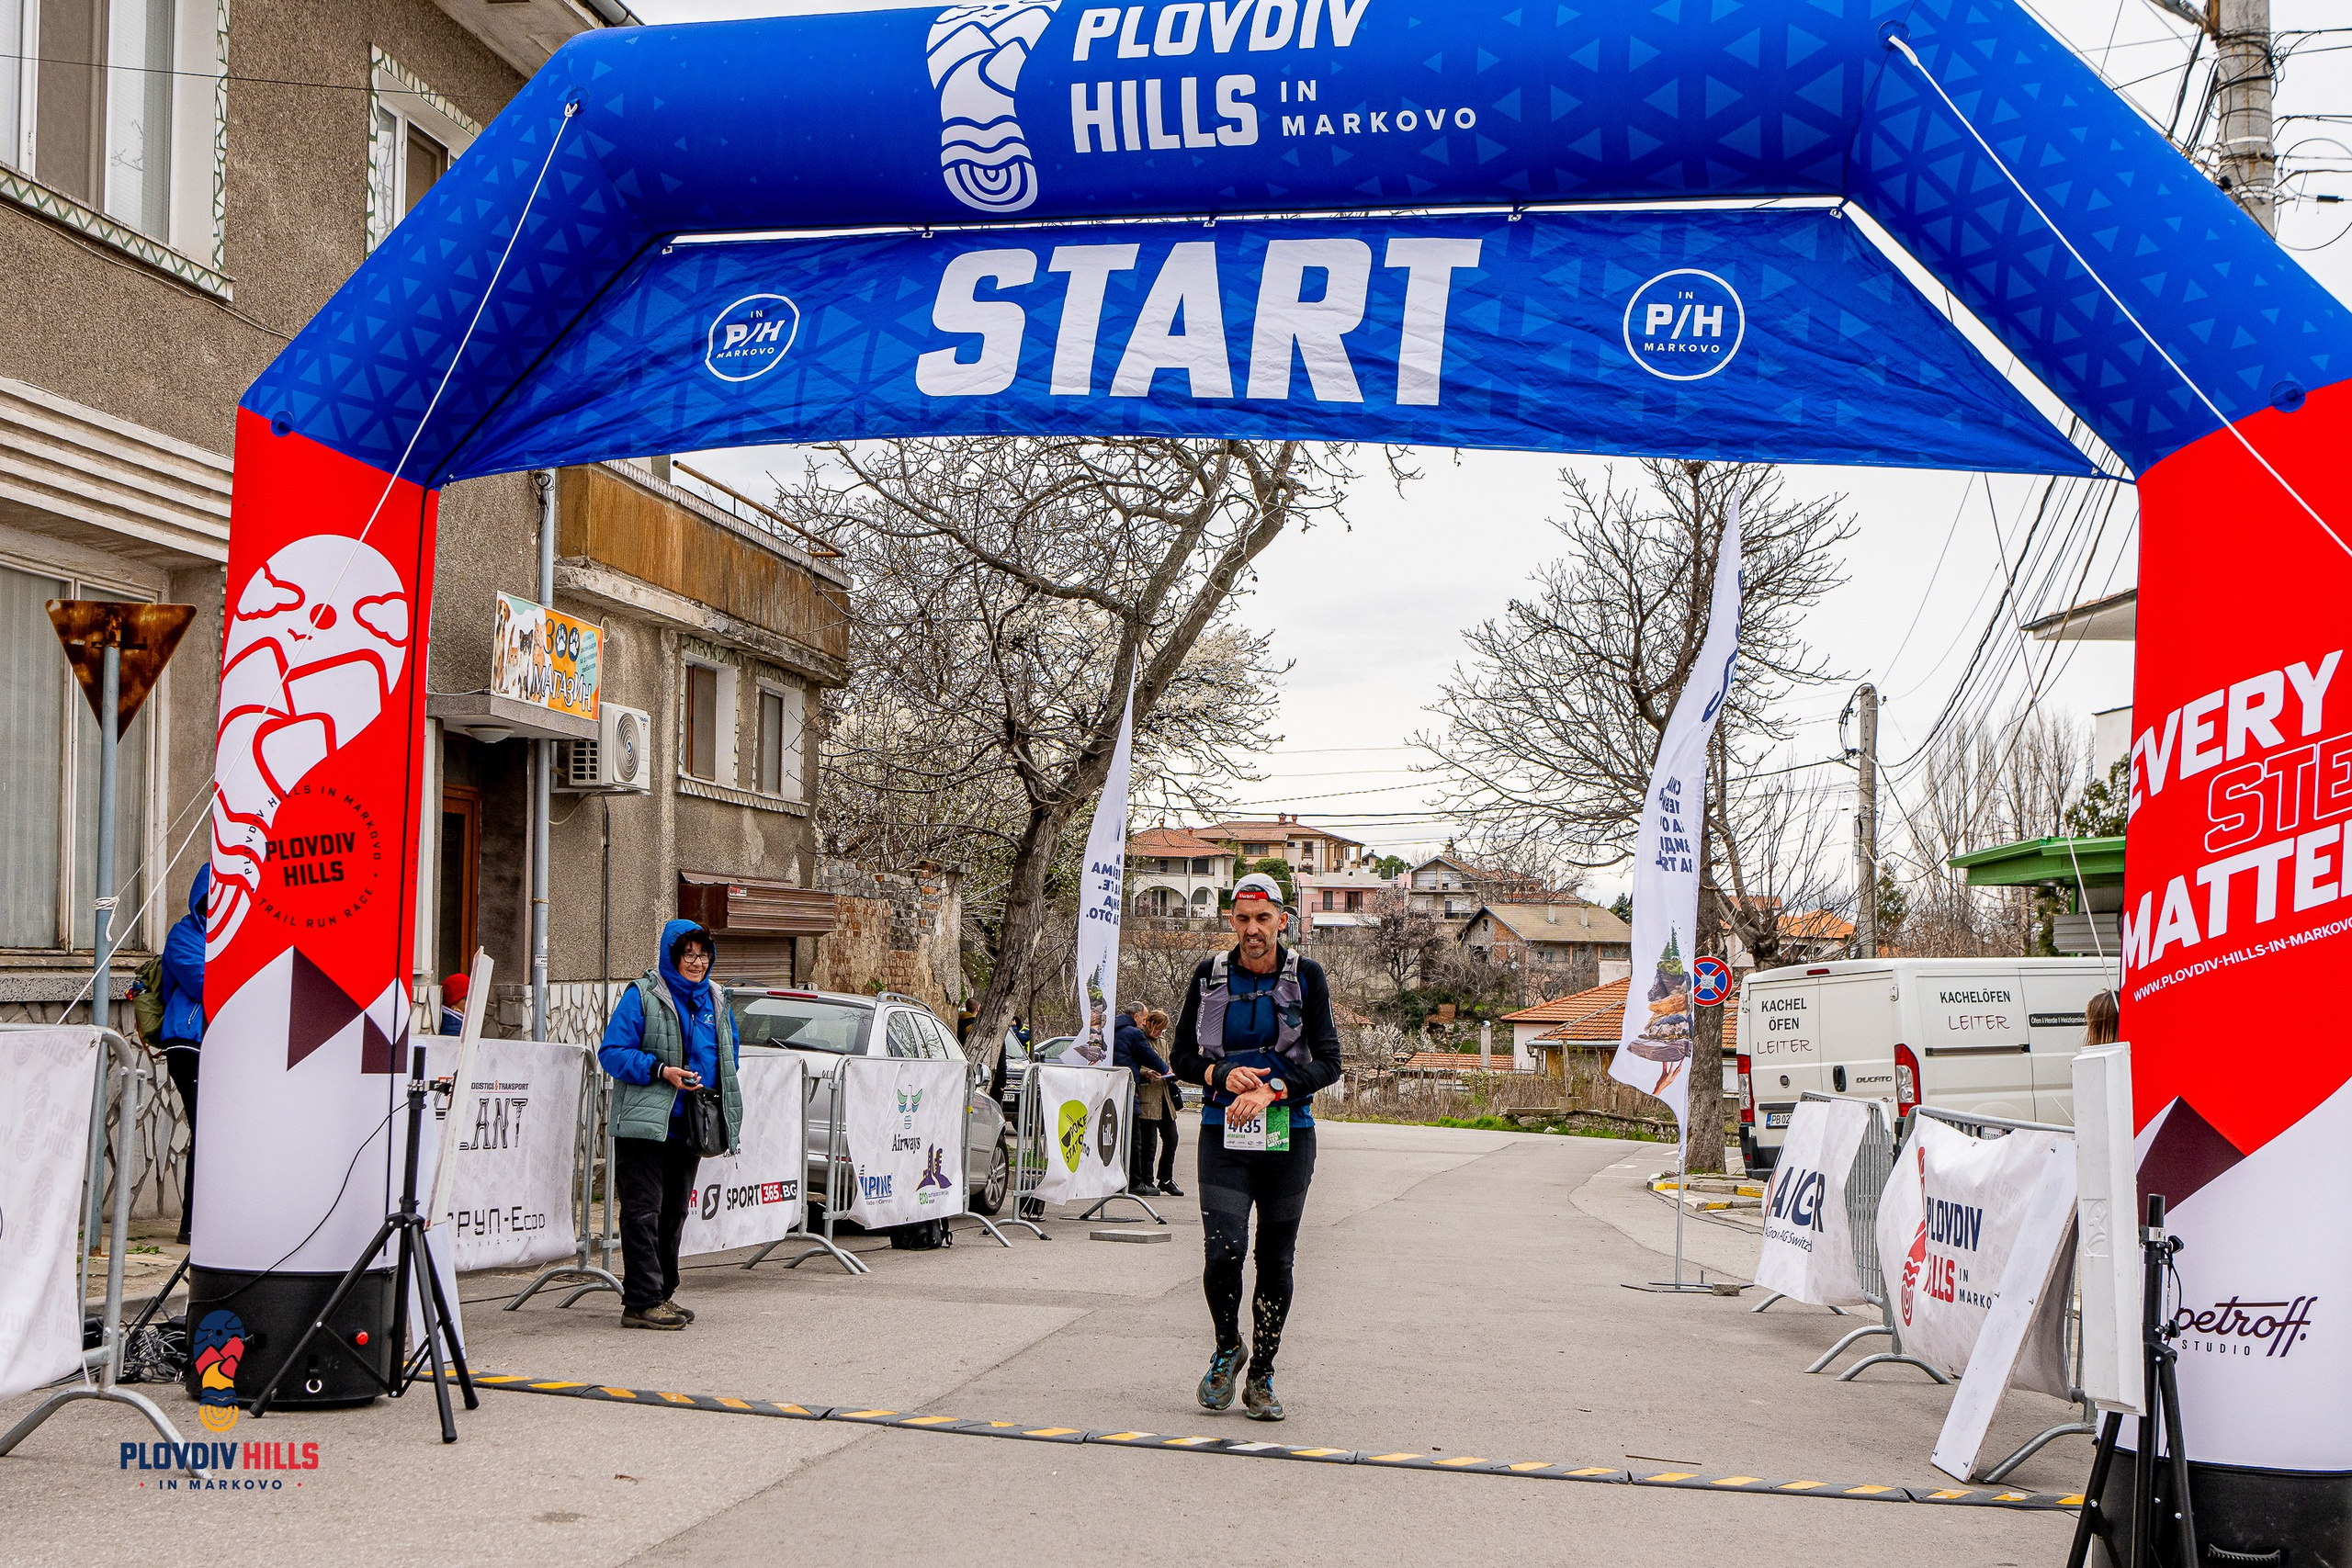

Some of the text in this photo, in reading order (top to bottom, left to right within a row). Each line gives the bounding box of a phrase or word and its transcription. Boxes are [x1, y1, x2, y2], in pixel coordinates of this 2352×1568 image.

[1072, 0, 1371, 62] PLOVDIV
[1281, 80, 1317, 103] IN
[1071, 74, 1259, 152] HILLS
[1282, 107, 1476, 137] MARKOVO
[1679, 291, 1693, 299] IN
[750, 310, 763, 319] IN
[915, 238, 1483, 406] START
[1645, 304, 1724, 340] P/H
[724, 320, 786, 350] P/H
[717, 347, 775, 359] MARKOVO
[1645, 343, 1720, 354] MARKOVO
[532, 663, 592, 712] МАГАЗИН
[2128, 649, 2343, 824] EVERY
[2205, 730, 2352, 854] STE
[243, 809, 265, 875] PLOVDIV
[267, 784, 311, 807] HILLS
[321, 785, 336, 797] IN
[344, 795, 381, 861] MARKOVO
[265, 831, 356, 863] PLOVDIV
[283, 860, 345, 887] HILLS
[258, 887, 373, 929] TRAIL RUN RACE
[1761, 998, 1807, 1013] KACHEL
[1939, 987, 2011, 1004] KACHELÖFEN
[1769, 1017, 1800, 1032] ÖFEN
[1948, 1015, 2010, 1031] LEITER
[1757, 1039, 1813, 1055] LEITER
[498, 1082, 529, 1090] TRANSPORT
[1856, 1076, 1893, 1084] DUCATO
[459, 1098, 528, 1151] ANT
[1782, 1114, 1792, 1124] 02
[891, 1134, 922, 1155] Airways
[1927, 1196, 1983, 1252] PLOVDIV
[1959, 1268, 1969, 1282] IN
[1959, 1288, 1993, 1310] MARKO
[2164, 1295, 2318, 1359] petroff.
[2181, 1339, 2251, 1356] STUDIO
